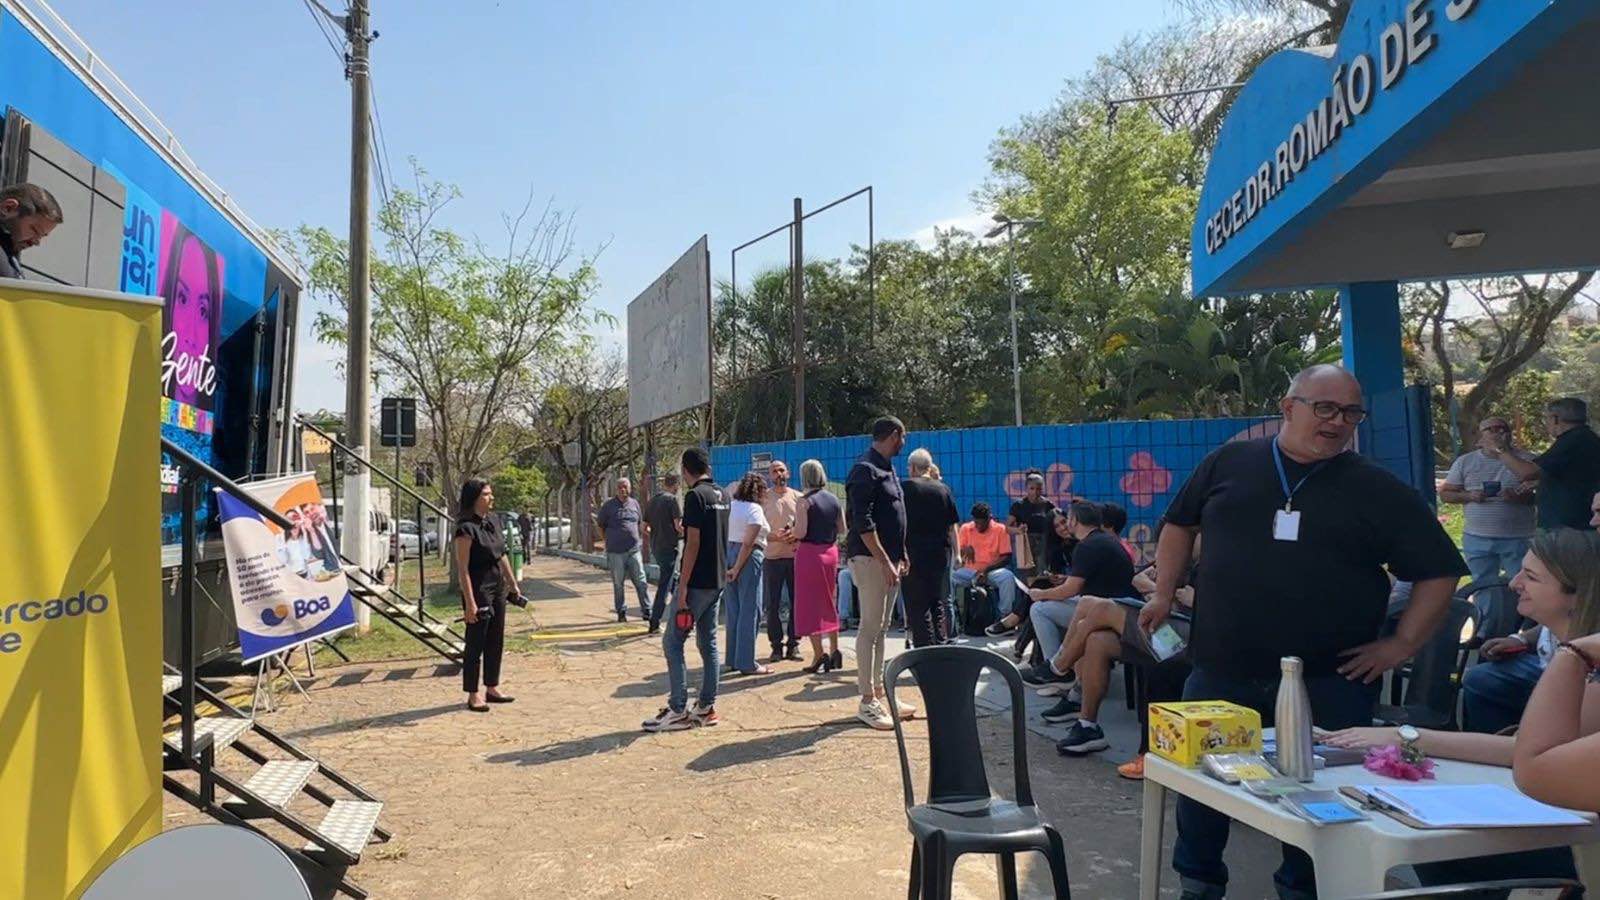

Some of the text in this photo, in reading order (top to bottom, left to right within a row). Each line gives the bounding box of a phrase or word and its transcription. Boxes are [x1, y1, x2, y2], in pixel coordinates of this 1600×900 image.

[1379, 0, 1433, 90] DE
[0, 590, 109, 625] rcado
[293, 596, 331, 620] Boa
